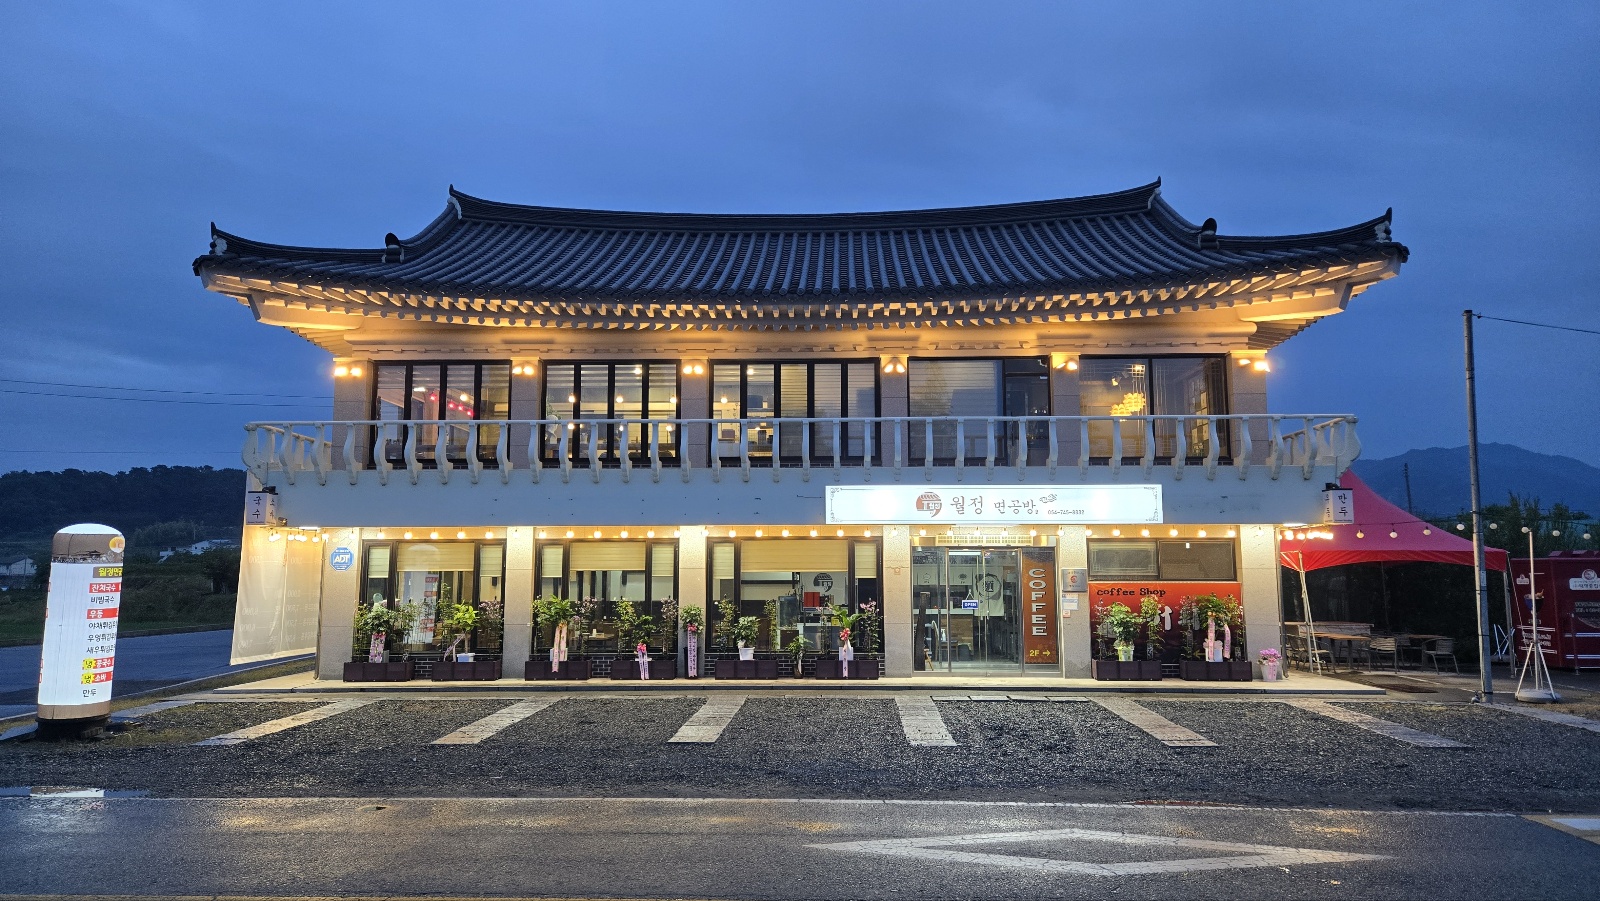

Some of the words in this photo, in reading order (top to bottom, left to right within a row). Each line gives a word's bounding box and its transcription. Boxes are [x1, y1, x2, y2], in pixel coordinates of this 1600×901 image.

[252, 495, 262, 519] 국수
[950, 495, 983, 515] 월정
[993, 499, 1037, 515] 면공방
[1338, 493, 1348, 517] 만두
[334, 554, 350, 563] ADT
[91, 583, 116, 592] 잔치국수
[1097, 588, 1135, 596] coffee
[1139, 588, 1166, 597] Shop
[90, 595, 115, 605] 비빔국수
[1028, 568, 1048, 636] COFFEE
[88, 609, 104, 619] 우동
[1029, 649, 1040, 657] 2F
[82, 688, 97, 698] 만두
